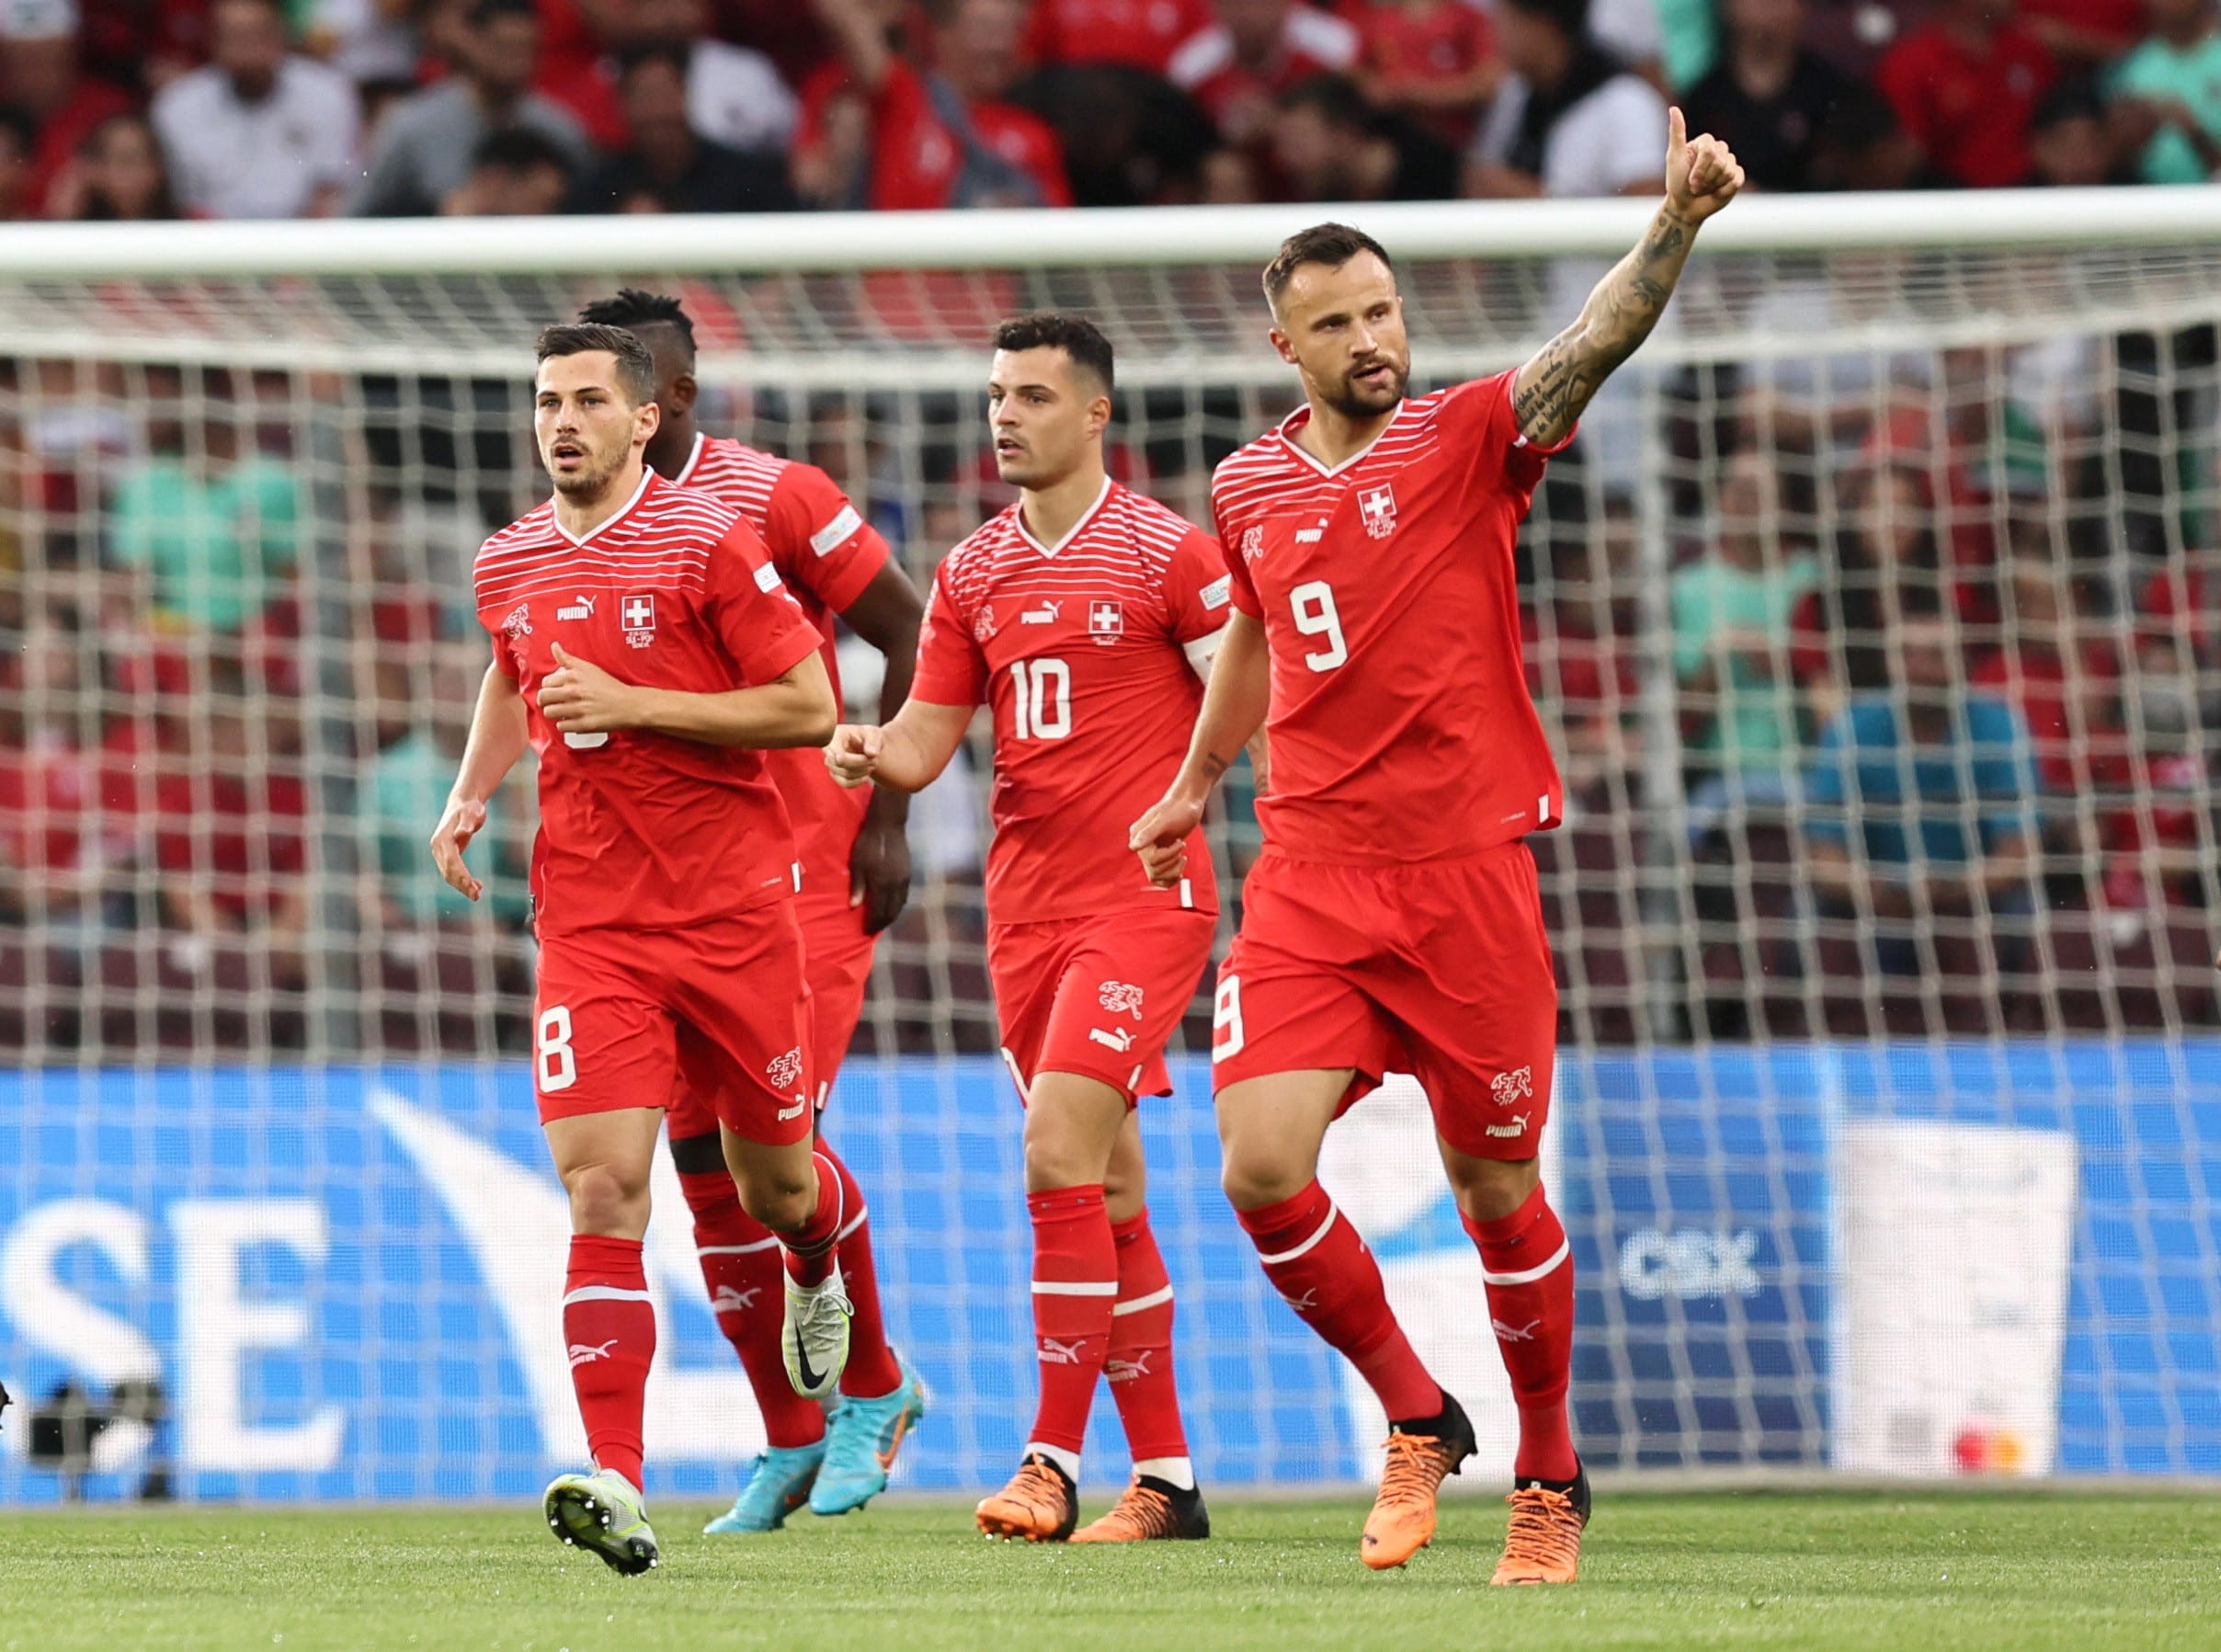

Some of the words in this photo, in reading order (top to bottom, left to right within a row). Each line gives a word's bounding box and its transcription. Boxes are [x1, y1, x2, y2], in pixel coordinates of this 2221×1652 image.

[557, 606, 588, 621] PUMA
[1289, 580, 1348, 673] 9
[1011, 658, 1072, 739] 10
[538, 1005, 577, 1093] 8
[1213, 974, 1245, 1064] 9
[1486, 1124, 1522, 1137] PUMA
[0, 1197, 347, 1473] SE
